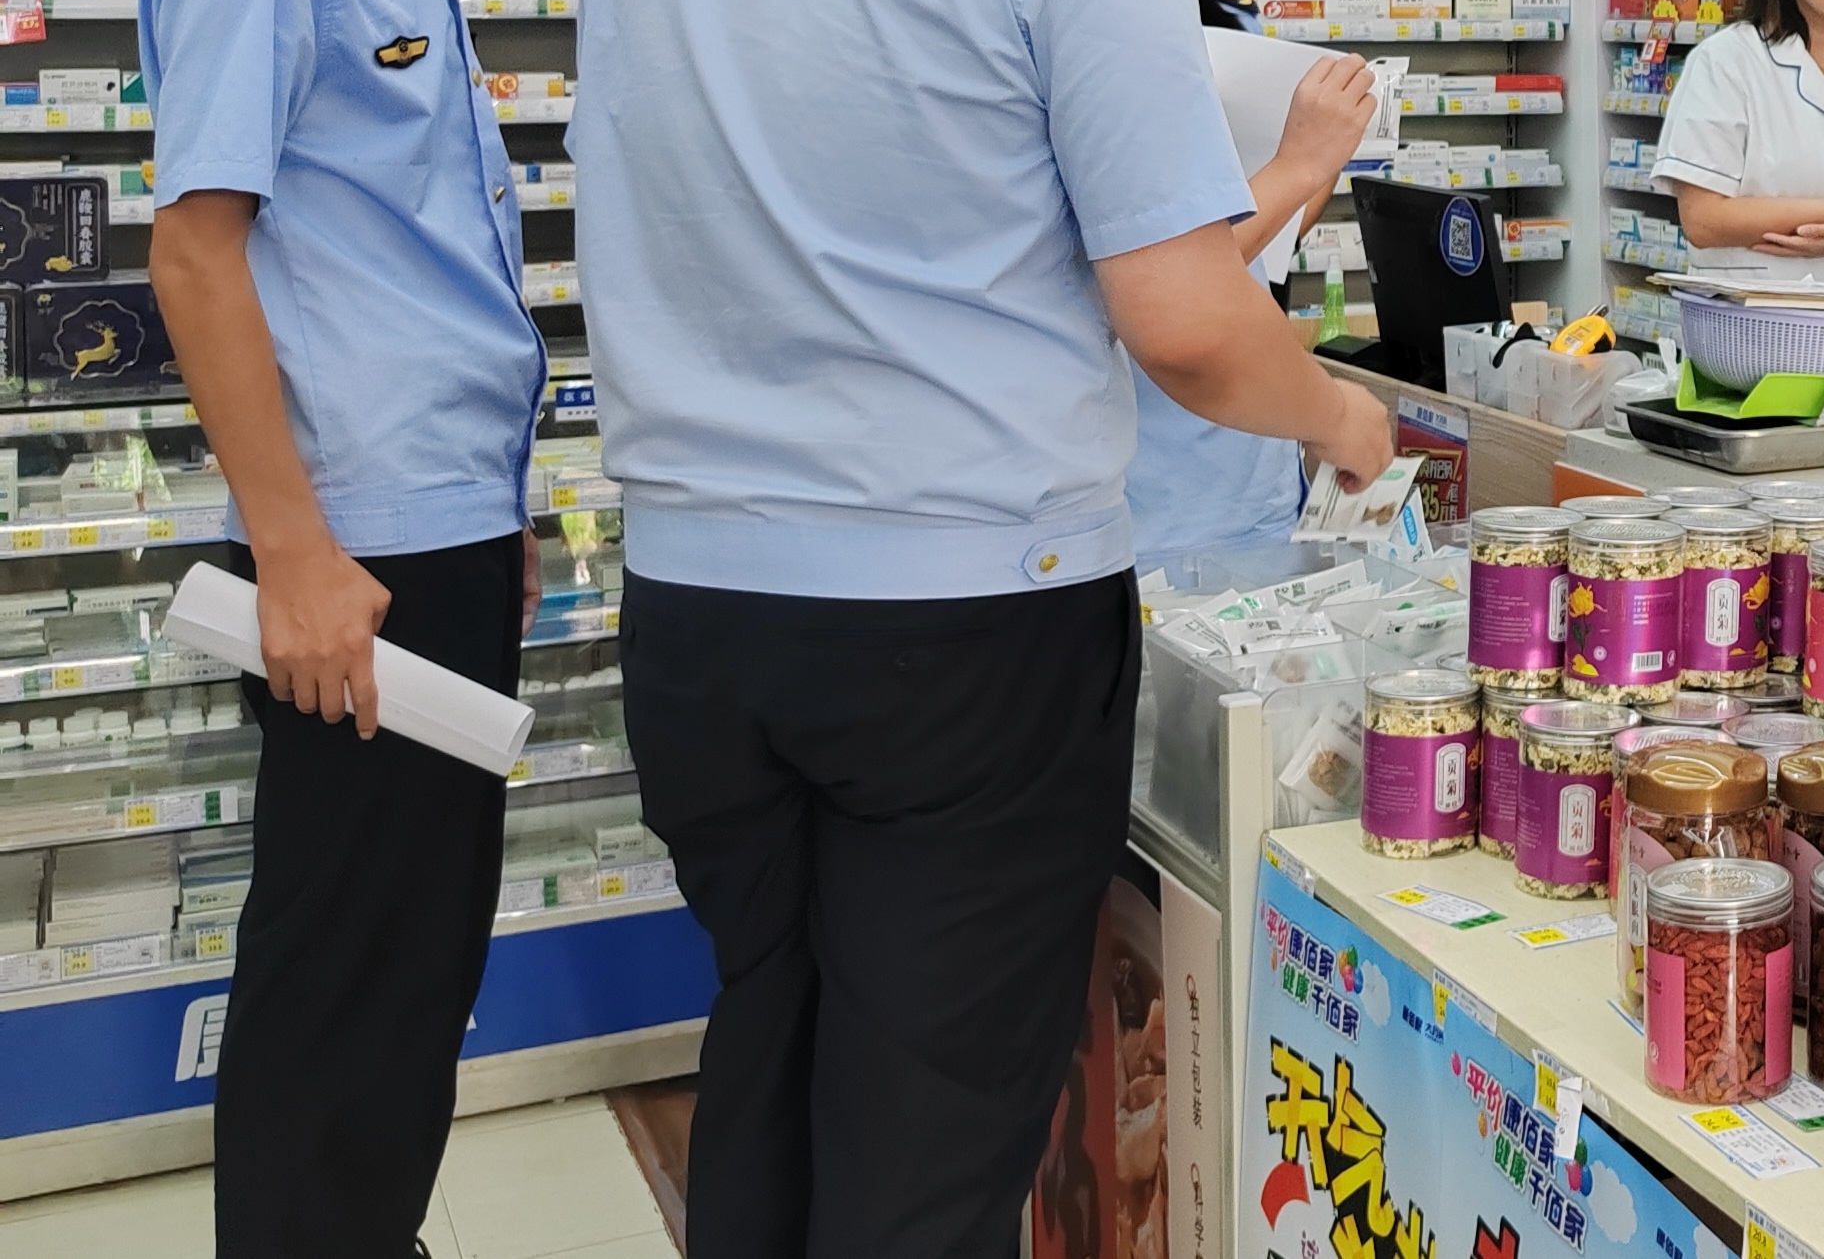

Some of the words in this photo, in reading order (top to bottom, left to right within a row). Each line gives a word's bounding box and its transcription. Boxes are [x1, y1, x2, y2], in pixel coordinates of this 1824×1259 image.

[1717, 593, 1729, 631] 贡菊
[1446, 758, 1458, 798] 贡菊
[1571, 800, 1584, 841] 贡菊
